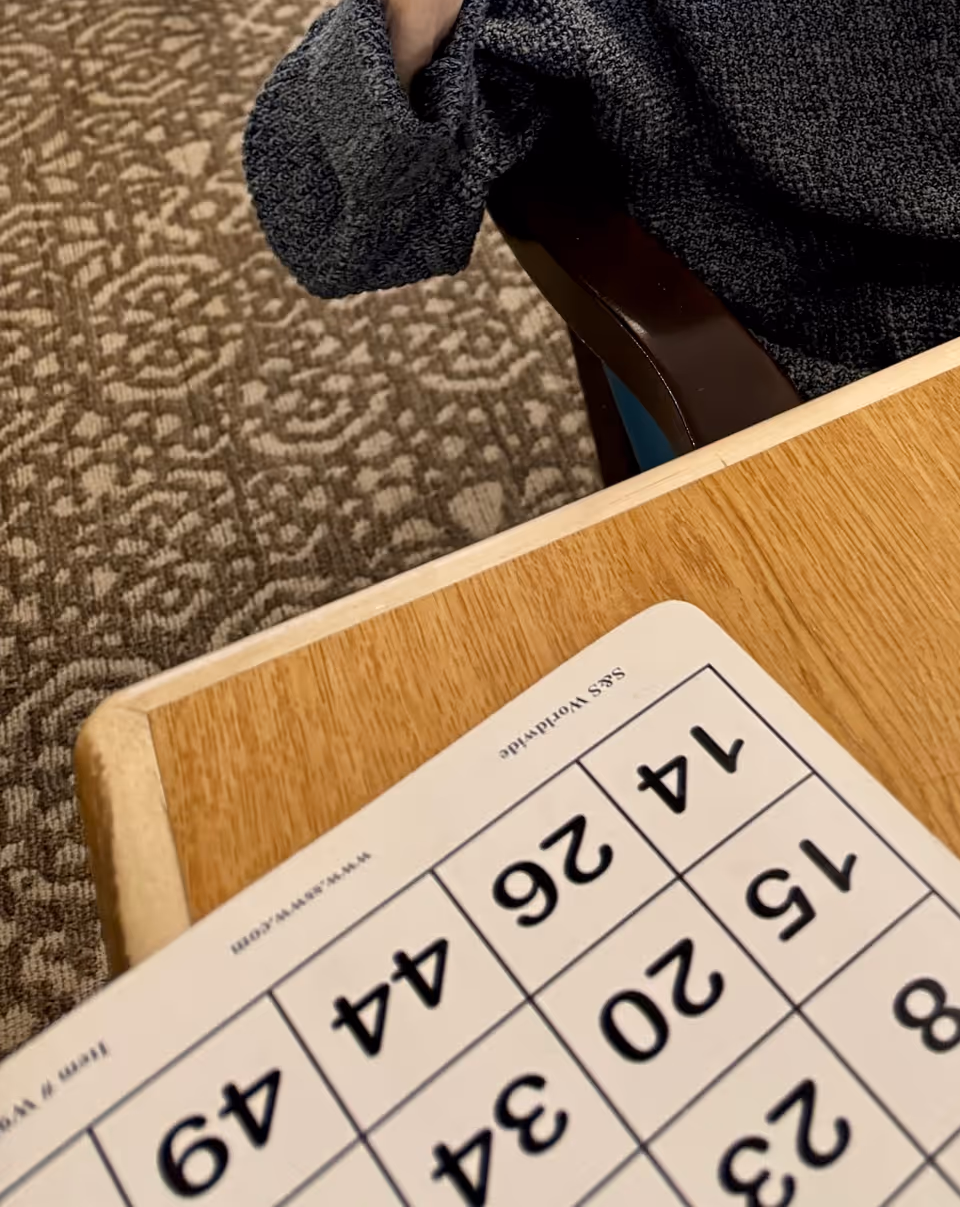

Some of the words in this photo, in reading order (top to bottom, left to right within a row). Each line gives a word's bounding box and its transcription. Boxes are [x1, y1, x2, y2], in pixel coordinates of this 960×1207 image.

[500, 697, 589, 758] Worldwide
[588, 667, 625, 697] S&S
[637, 726, 744, 814] 14
[493, 815, 613, 927] 26
[746, 840, 857, 942] 15
[332, 939, 448, 1057] 44
[600, 938, 724, 1063] 20
[158, 1069, 281, 1198] 49
[432, 1074, 568, 1207] 34
[718, 1079, 851, 1207] 23
